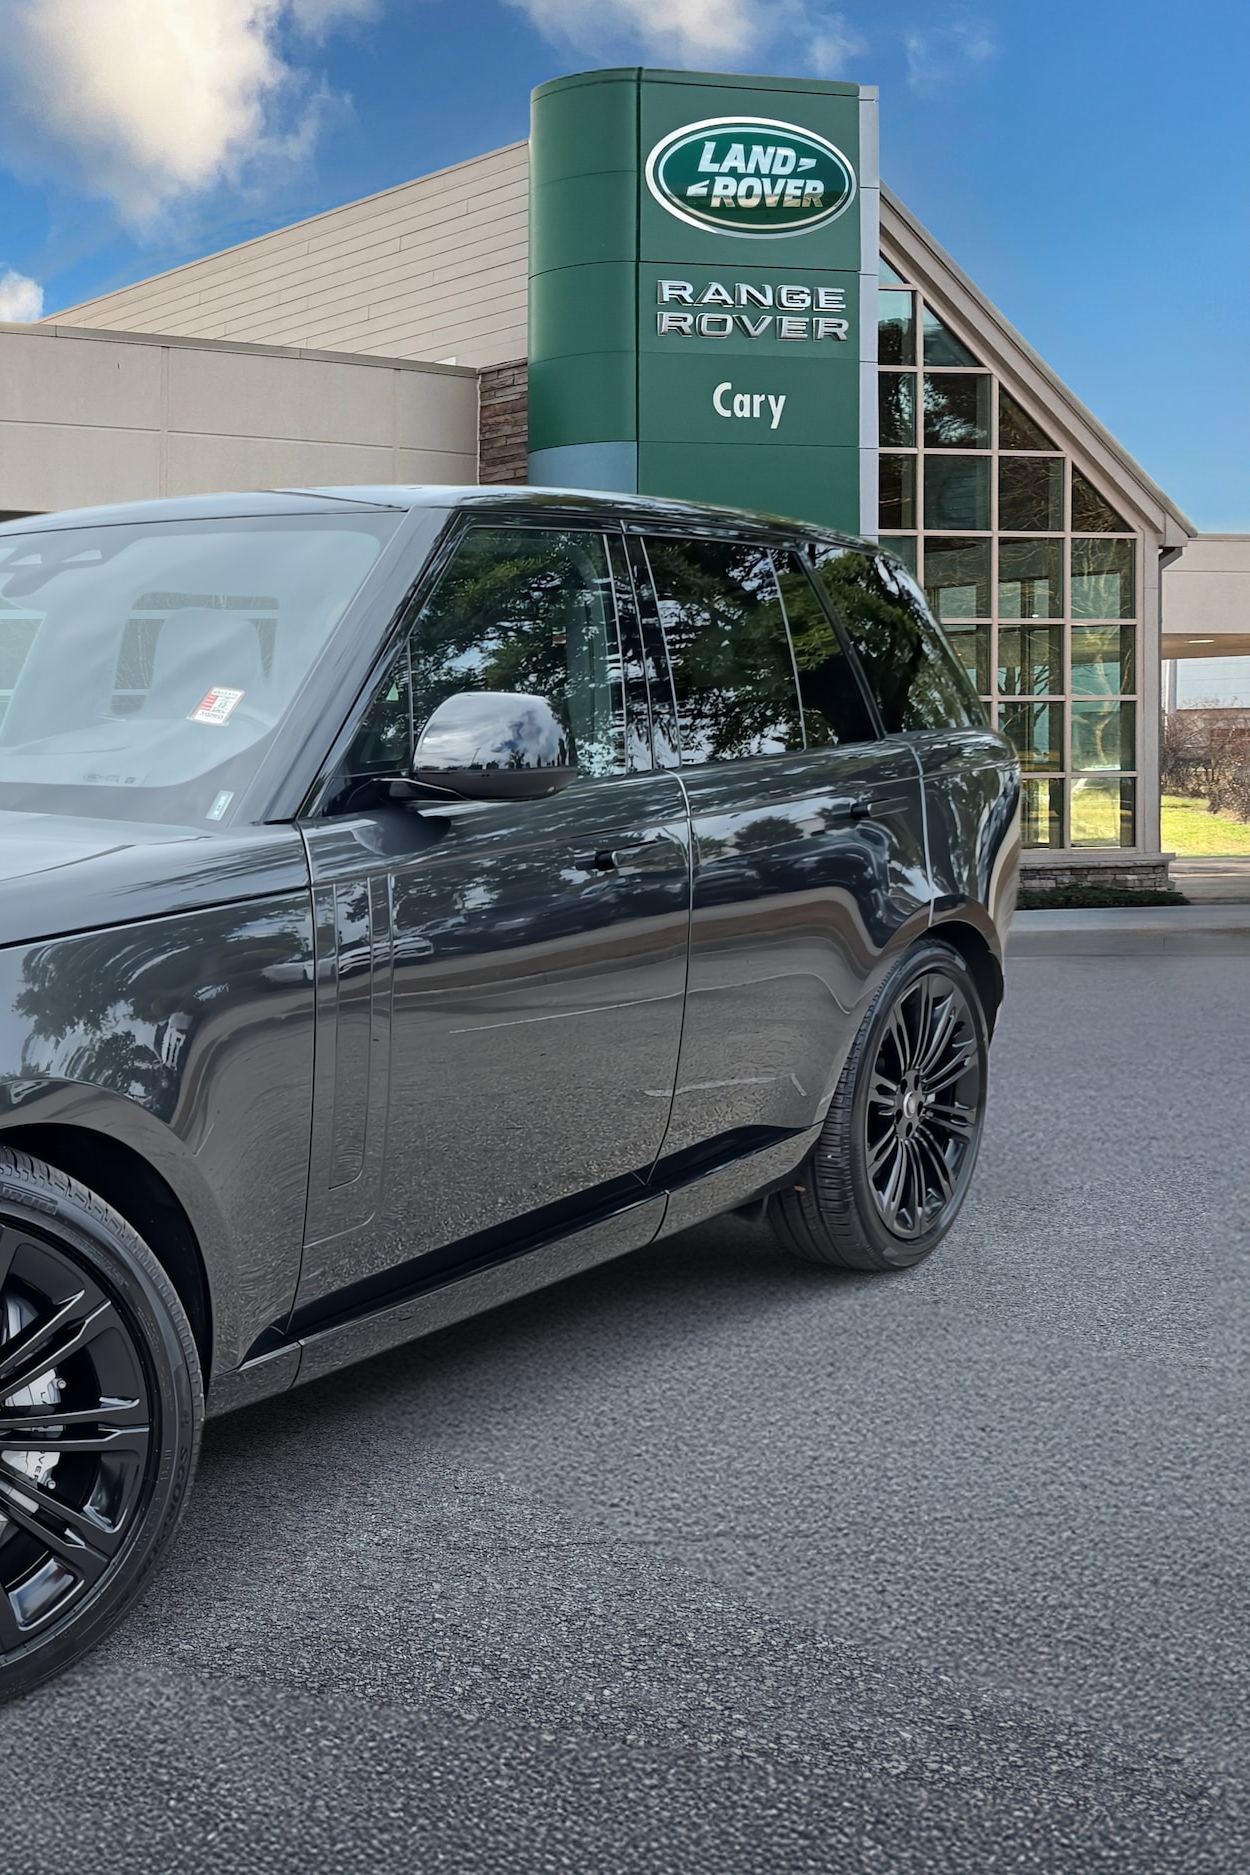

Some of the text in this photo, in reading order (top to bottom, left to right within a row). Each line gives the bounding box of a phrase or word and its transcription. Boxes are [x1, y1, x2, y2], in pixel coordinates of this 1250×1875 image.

[697, 141, 797, 175] LAND
[710, 176, 825, 208] ROVER
[657, 280, 847, 312] RANGE
[657, 311, 850, 342] ROVER
[712, 382, 787, 430] Cary
